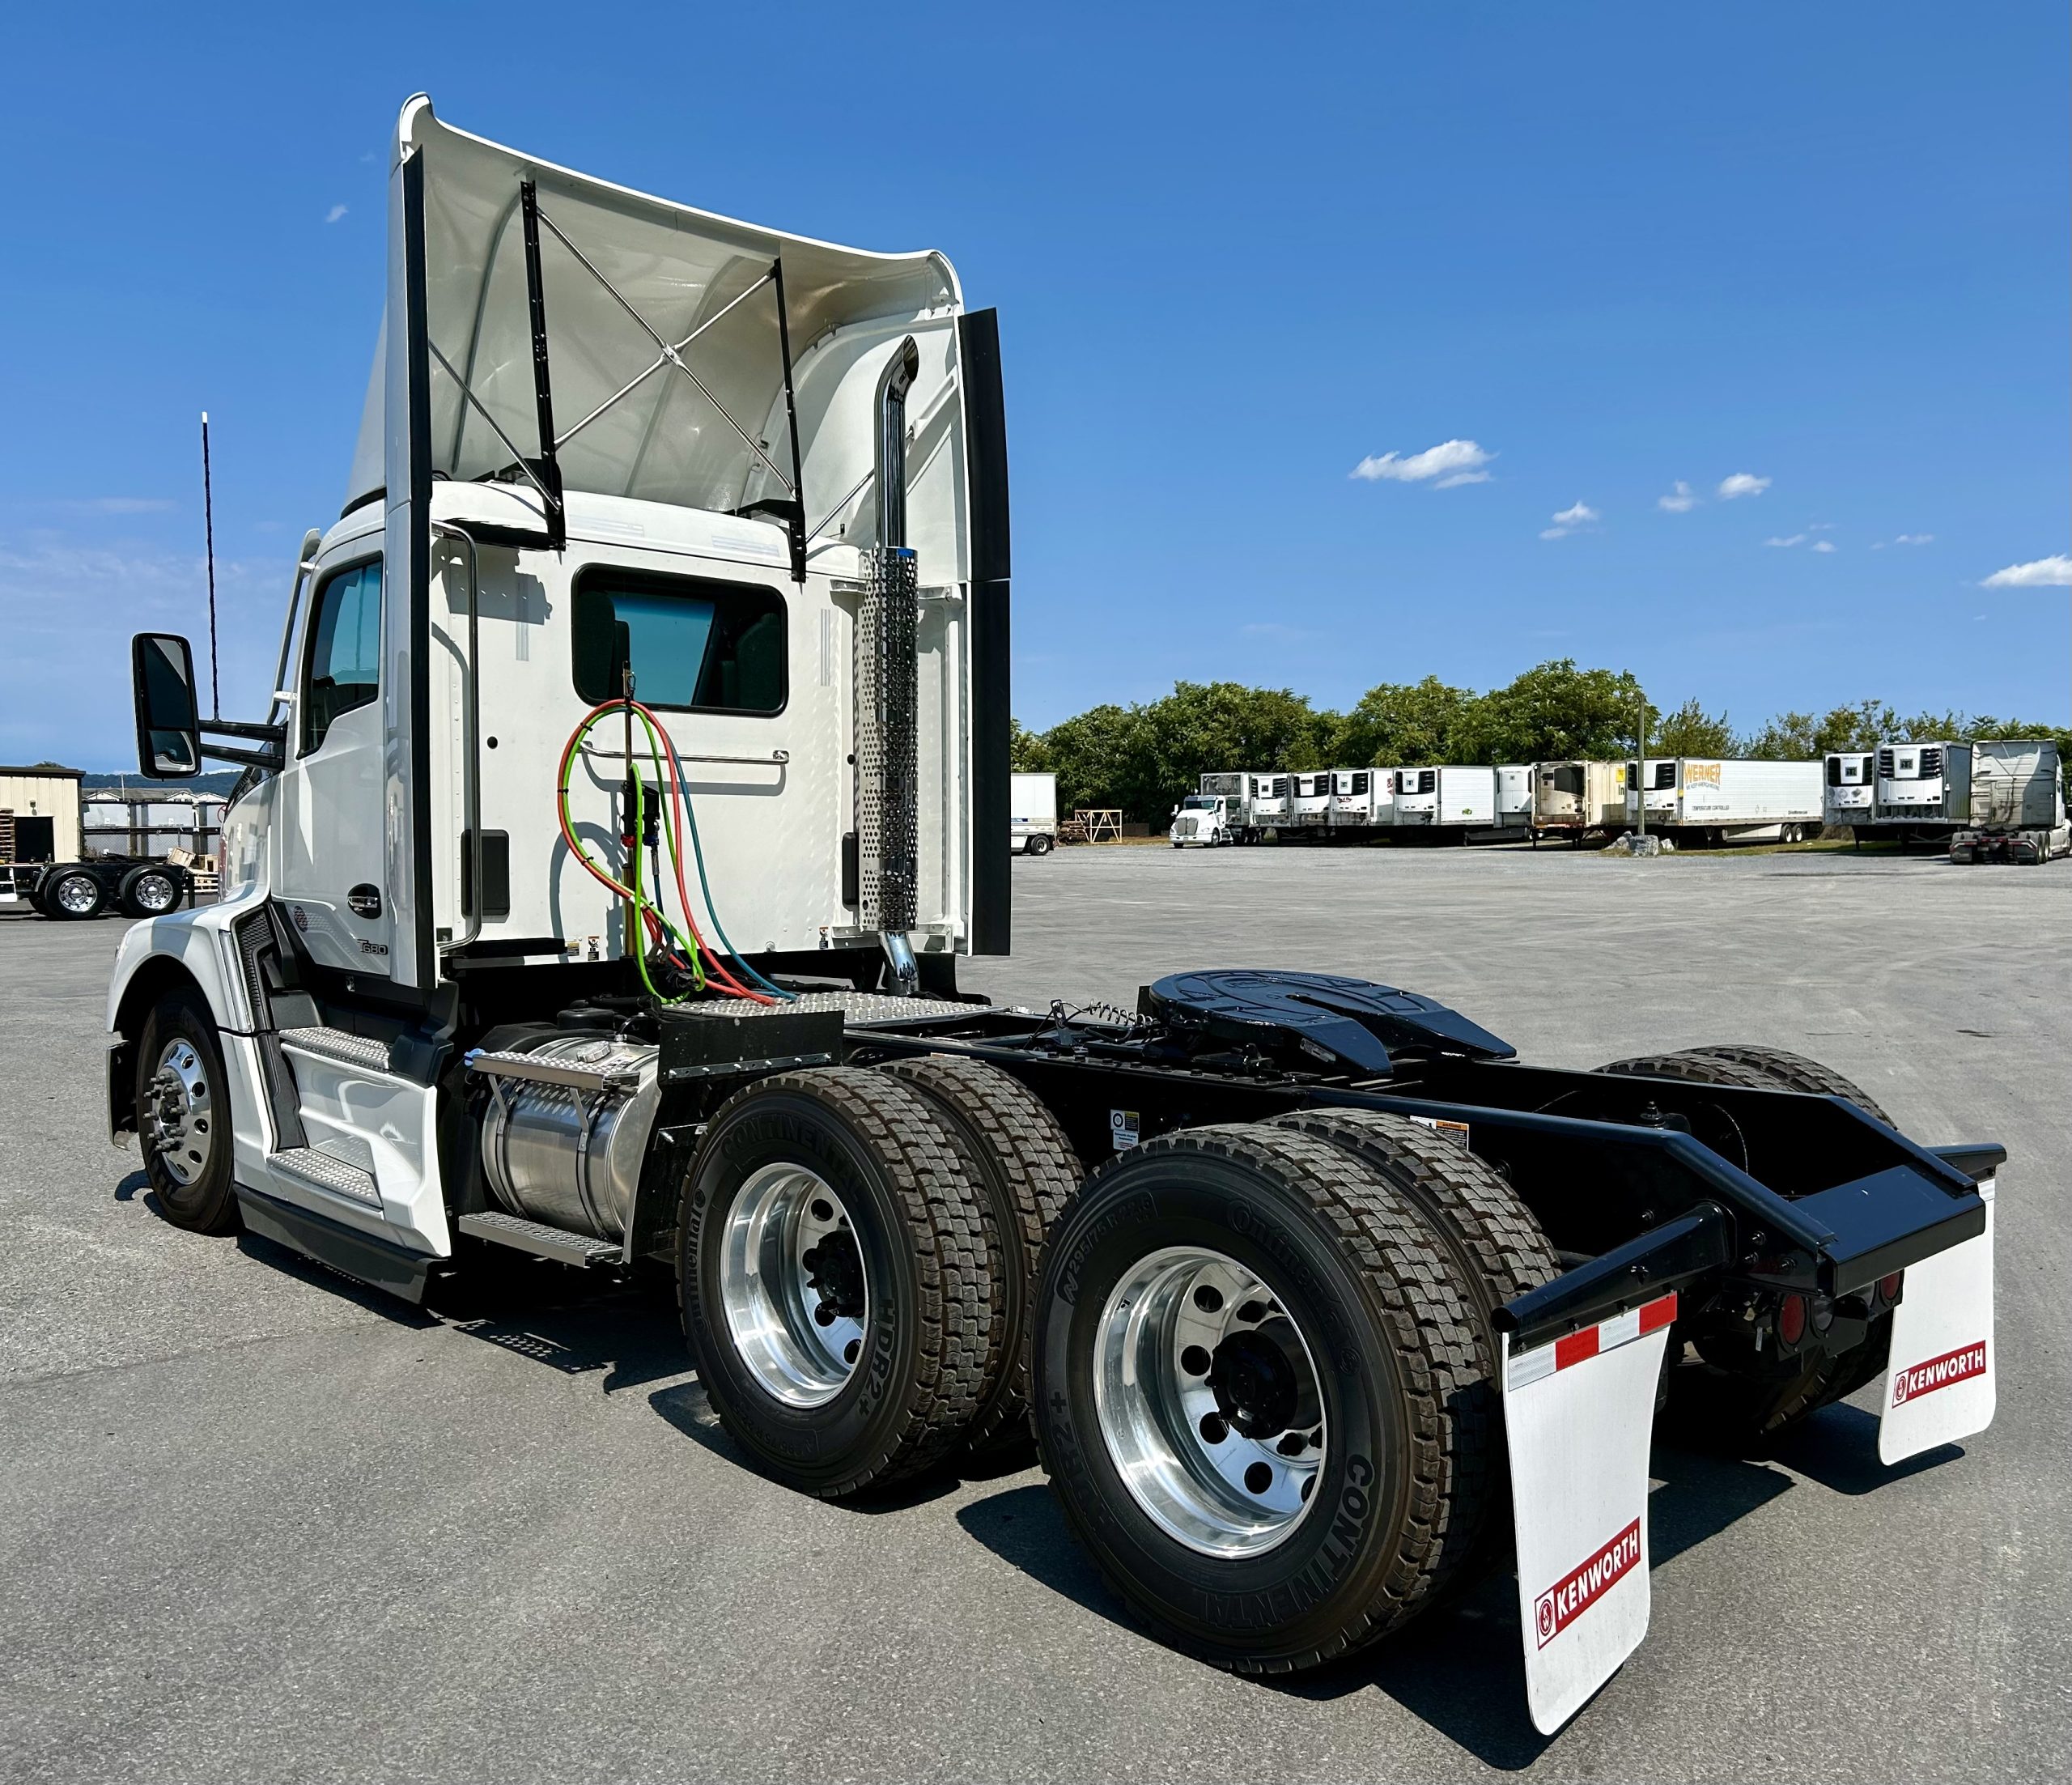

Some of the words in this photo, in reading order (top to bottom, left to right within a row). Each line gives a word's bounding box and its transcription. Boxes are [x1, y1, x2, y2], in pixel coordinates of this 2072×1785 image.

[1684, 763, 1721, 785] WERNER
[356, 939, 388, 955] T680
[720, 1112, 864, 1205] CONTINENTAL
[1068, 1220, 1108, 1275] 295/75
[856, 1297, 899, 1418] HDR2+
[1909, 1347, 1984, 1394] KENWORTH
[1193, 1453, 1375, 1630] CONTINENTAL
[1556, 1528, 1639, 1621] KENWORTH
